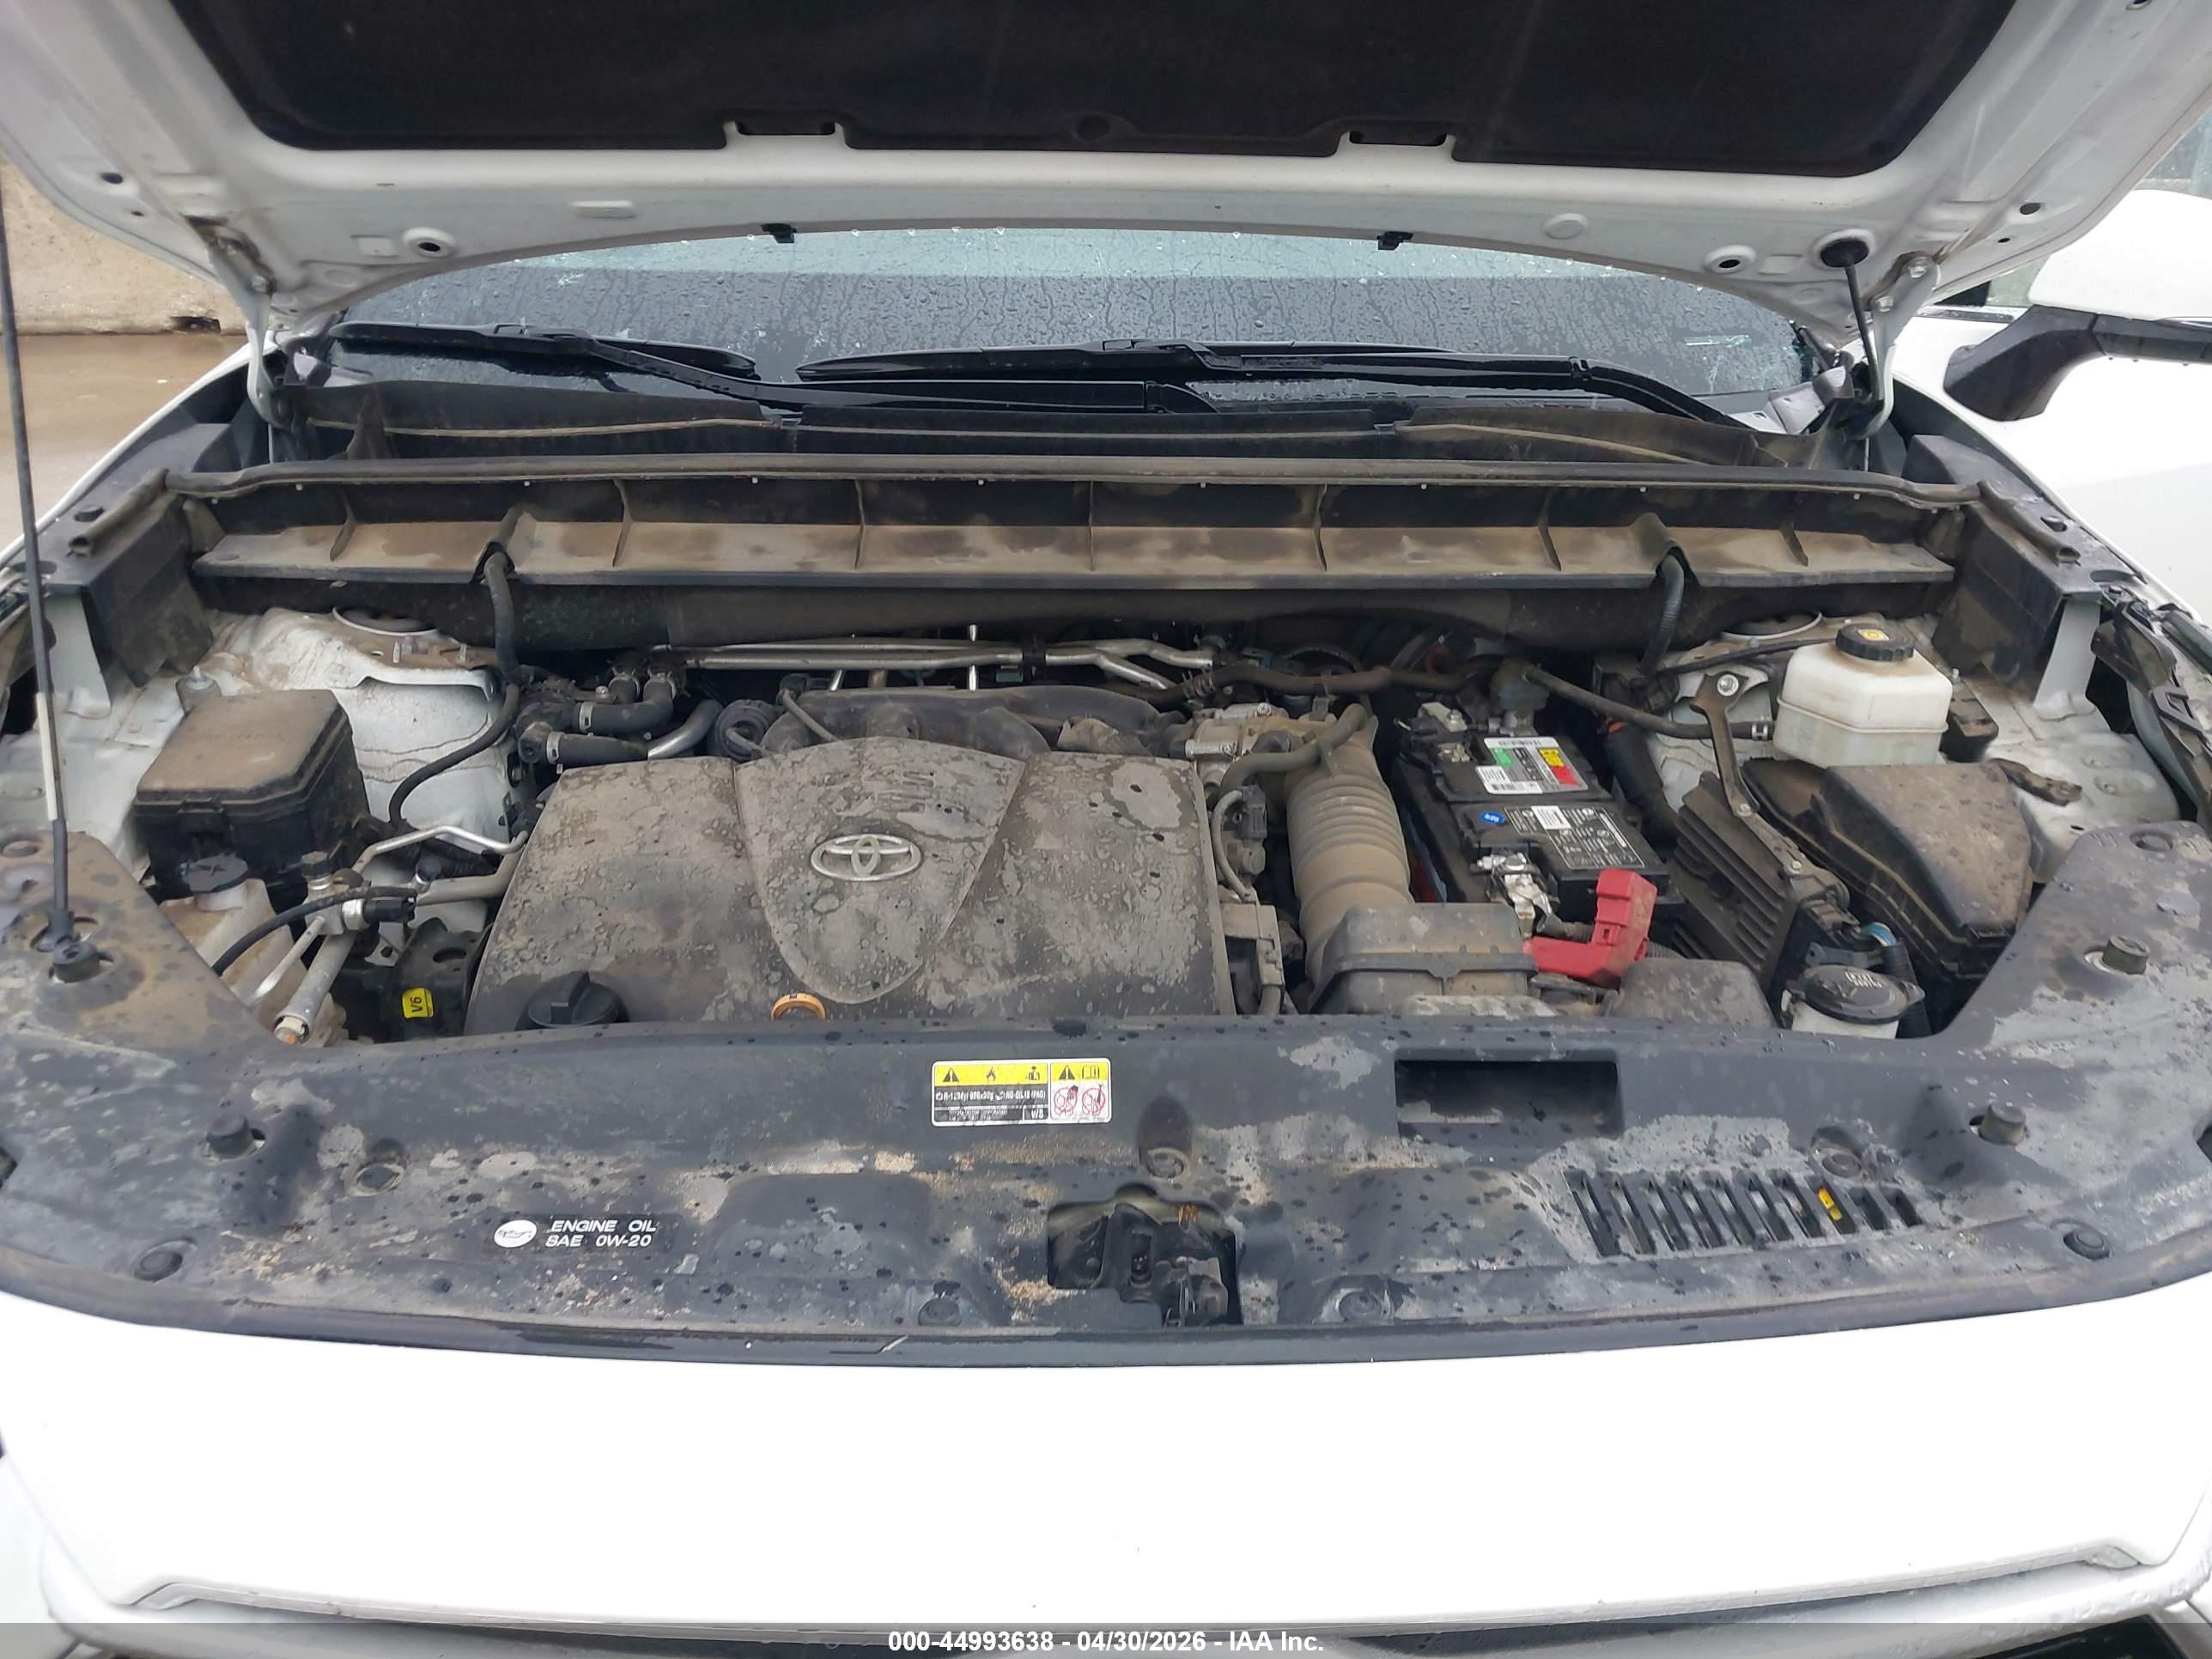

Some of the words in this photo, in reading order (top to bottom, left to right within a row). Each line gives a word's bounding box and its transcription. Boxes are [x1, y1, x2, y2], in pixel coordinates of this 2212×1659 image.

[410, 996, 422, 1012] V6
[551, 1219, 618, 1232] ENGINE
[629, 1219, 657, 1232] OIL
[545, 1234, 584, 1247] SAE
[595, 1234, 652, 1247] 0W-20
